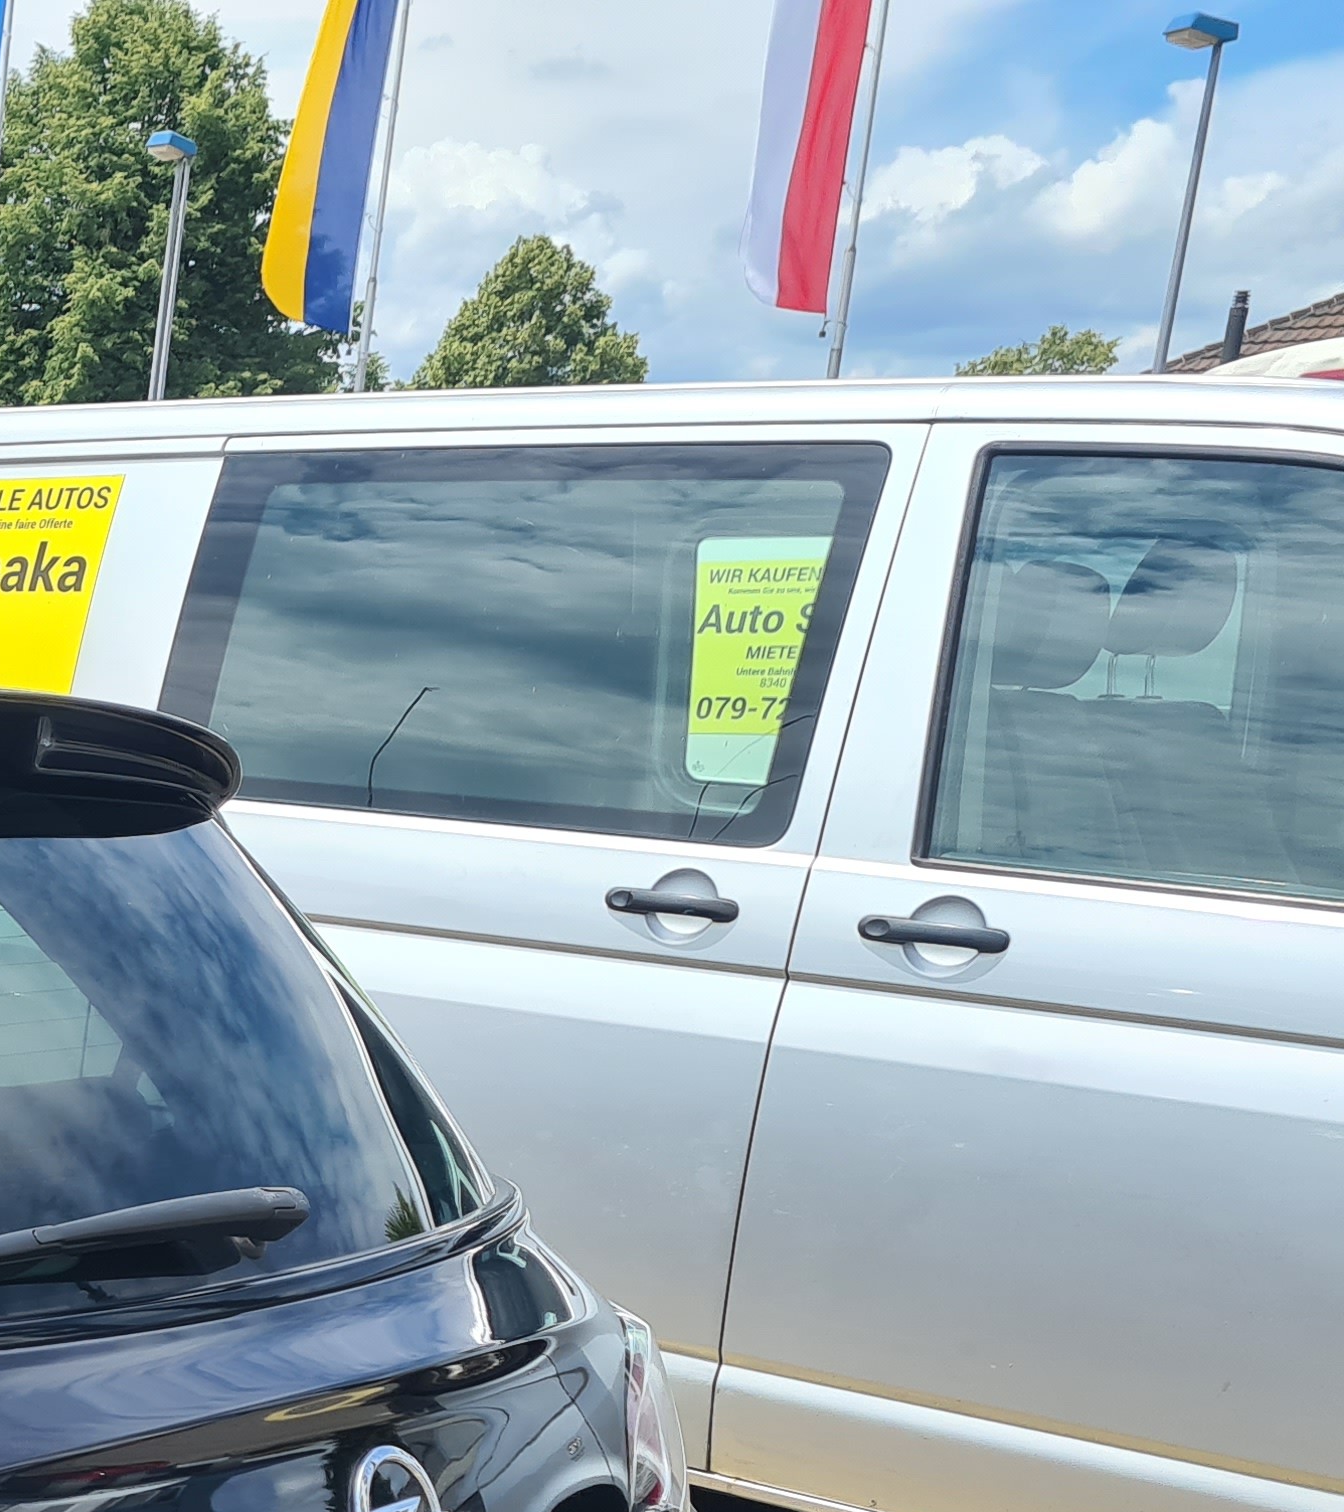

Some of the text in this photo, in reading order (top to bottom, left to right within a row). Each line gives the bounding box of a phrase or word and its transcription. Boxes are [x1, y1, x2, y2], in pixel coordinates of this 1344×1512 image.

[27, 486, 111, 511] AUTOS
[14, 518, 36, 531] faire
[38, 518, 73, 530] Offerte
[709, 567, 822, 584] WIR KAUFEN
[697, 604, 784, 634] Auto
[745, 645, 798, 660] MIETE
[736, 667, 765, 677] Untere
[760, 678, 786, 688] 8340
